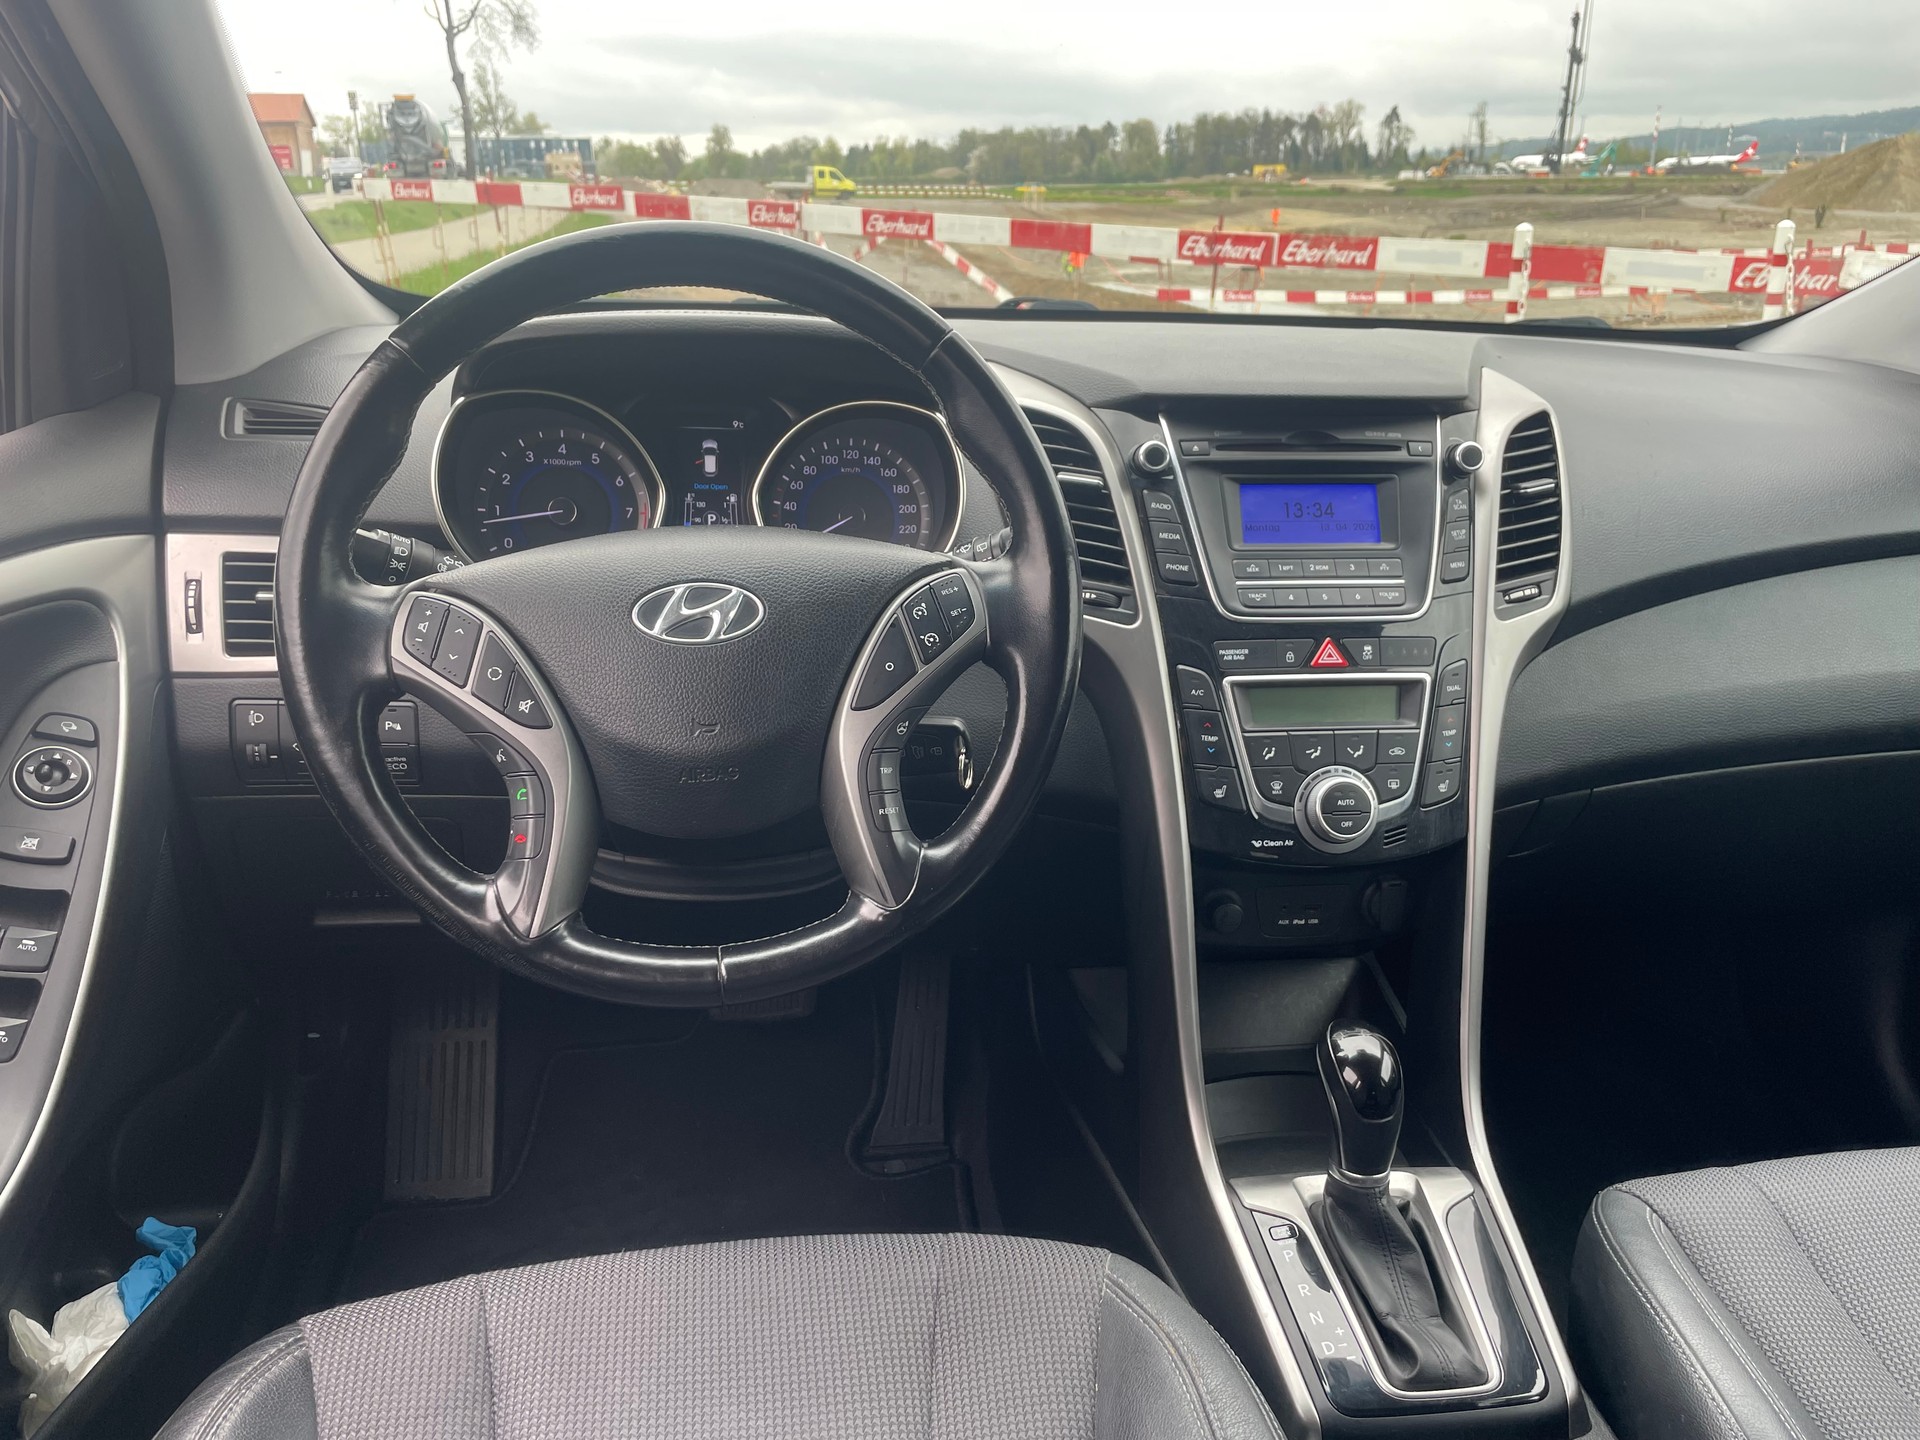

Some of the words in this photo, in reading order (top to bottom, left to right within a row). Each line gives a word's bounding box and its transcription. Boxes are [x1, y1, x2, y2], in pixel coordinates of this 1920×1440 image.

[865, 214, 931, 236] Eberhard
[1181, 235, 1267, 261] Eberhard
[1281, 239, 1374, 266] Eberhard
[558, 444, 567, 454] 4
[525, 452, 534, 463] 3
[591, 453, 600, 464] 5
[821, 455, 839, 465] 100
[842, 450, 859, 460] 120
[863, 456, 881, 466] 140
[803, 465, 817, 476] 80
[841, 466, 861, 474] km/h
[880, 468, 898, 478] 160
[502, 474, 511, 485] 2
[615, 476, 624, 487] 6
[790, 480, 804, 490] 60
[892, 484, 910, 494] 180
[495, 505, 500, 516] 1
[783, 501, 797, 511] 40
[898, 504, 917, 514] 200
[1151, 502, 1172, 511] RADIO
[1284, 501, 1335, 519] 13:34
[626, 508, 633, 518] 7
[707, 514, 717, 525] P
[898, 524, 917, 534] 220
[1245, 523, 1281, 533] Montag
[393, 534, 411, 544] AUTO
[1159, 532, 1181, 541] MEDIA
[504, 538, 513, 548] 0
[1165, 562, 1189, 572] PHONE
[1219, 648, 1249, 656] PASSENGER
[1191, 688, 1204, 696] A/C
[1446, 684, 1461, 692] DUAL
[1442, 729, 1457, 737] TEMP
[1201, 735, 1219, 743] TEMP
[879, 806, 899, 815] RESET
[1263, 839, 1281, 848] Clean
[1282, 839, 1294, 847] Air
[17, 944, 38, 952] AUTO
[1283, 1250, 1294, 1262] P
[1297, 1283, 1311, 1296] R
[1309, 1310, 1325, 1326] N
[1321, 1341, 1335, 1355] D
